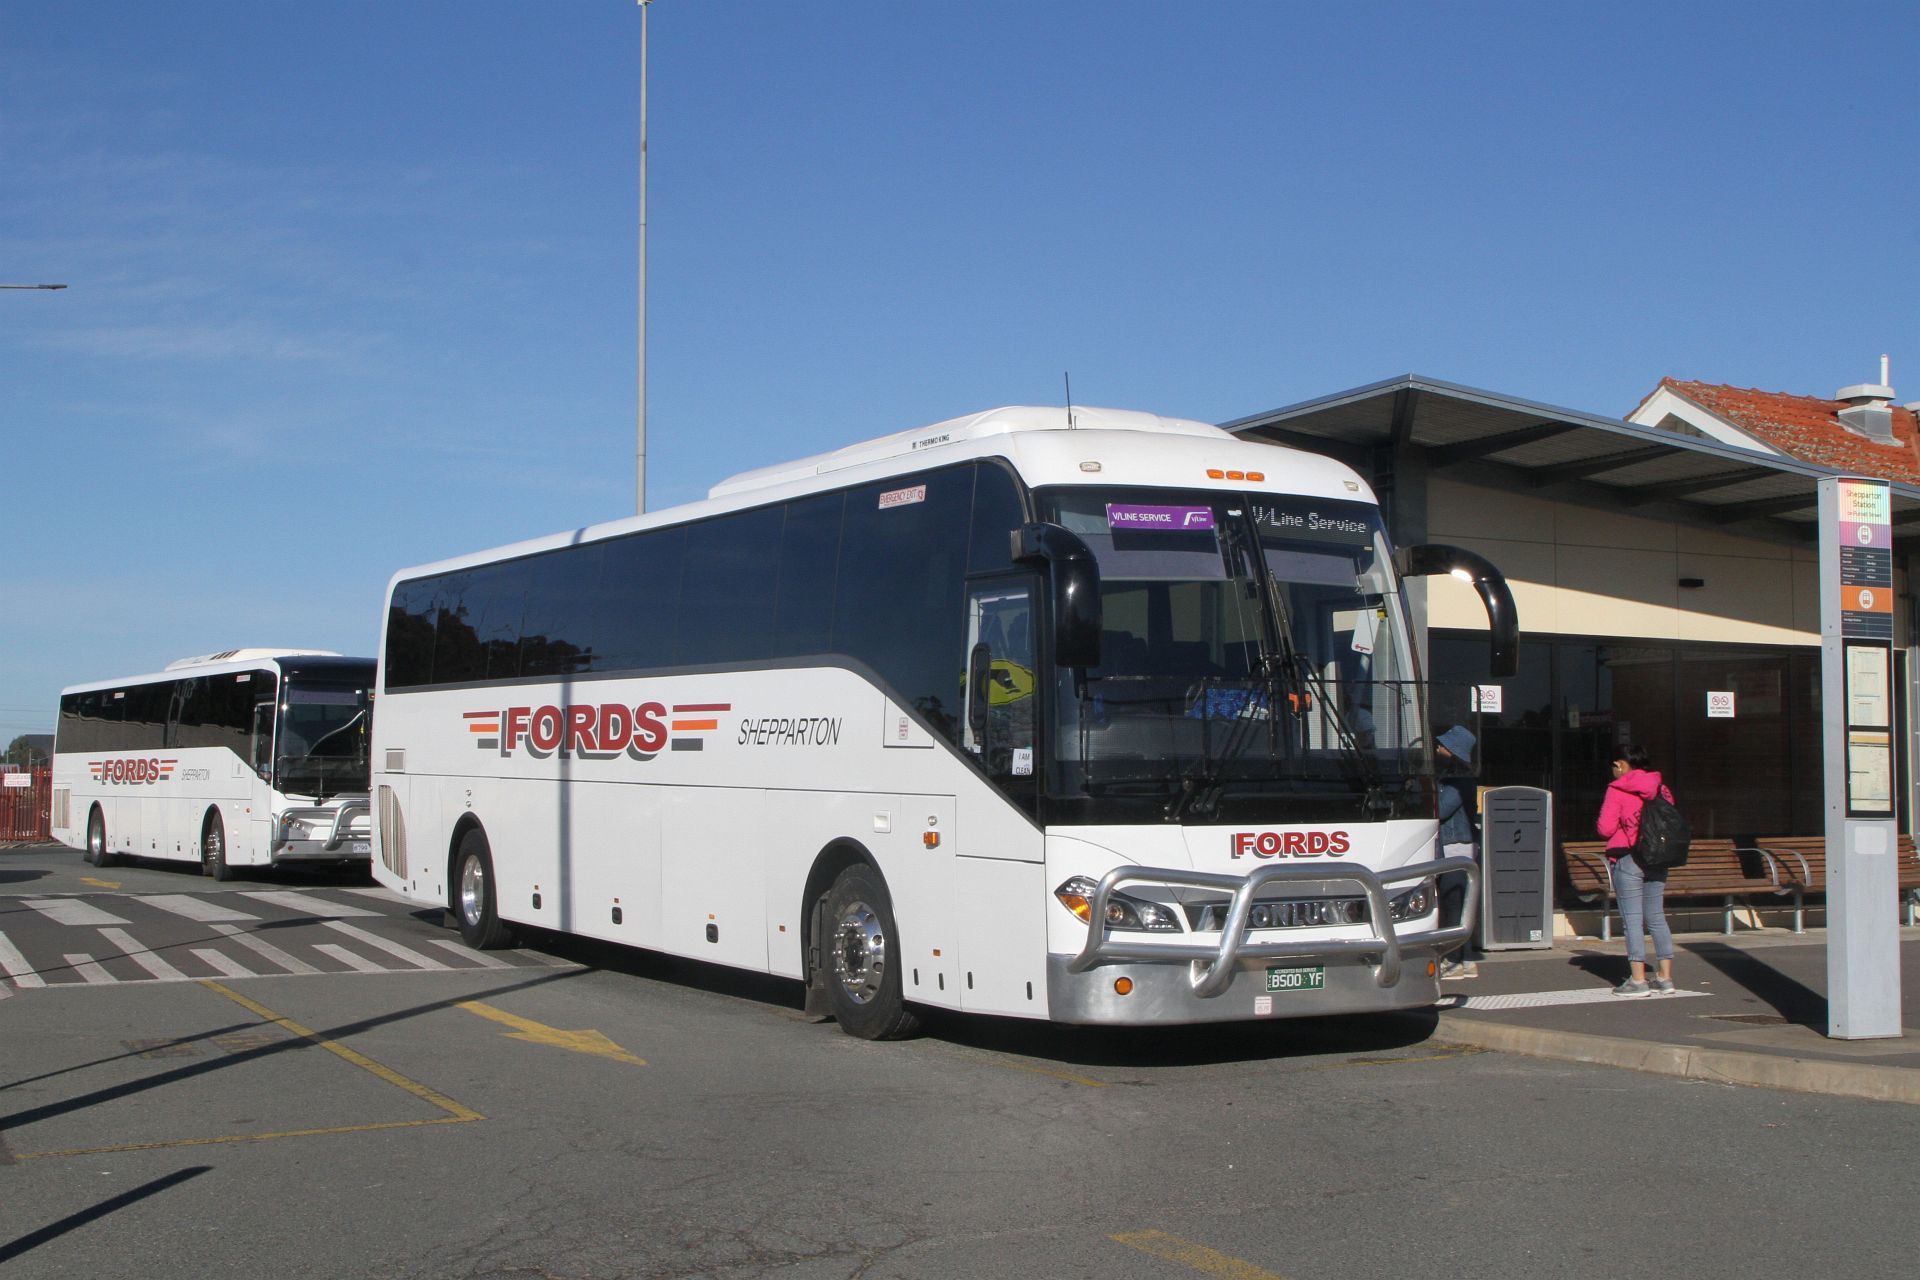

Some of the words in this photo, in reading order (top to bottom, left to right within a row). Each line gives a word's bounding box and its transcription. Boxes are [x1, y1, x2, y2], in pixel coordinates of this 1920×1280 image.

[919, 436, 938, 448] THERMO
[938, 434, 950, 442] KING
[880, 491, 906, 505] EMERGENCY
[906, 488, 917, 500] EXIT
[1846, 490, 1882, 500] Shepparton
[1852, 500, 1876, 509] Station
[1112, 511, 1138, 521] V/LINE
[1138, 512, 1172, 522] SERVICE
[1252, 505, 1304, 527] V/Line
[1308, 512, 1367, 533] Service
[501, 702, 668, 761] FORDS
[737, 717, 843, 746] SHEPPARTON
[1022, 752, 1030, 760] AM
[102, 758, 160, 785] FORDS
[181, 768, 210, 781] SHEPPARTON
[1015, 766, 1031, 775] CLEAN
[1231, 831, 1351, 860] FORDS
[1252, 901, 1352, 927] ONLUCK
[1309, 972, 1323, 986] YF
